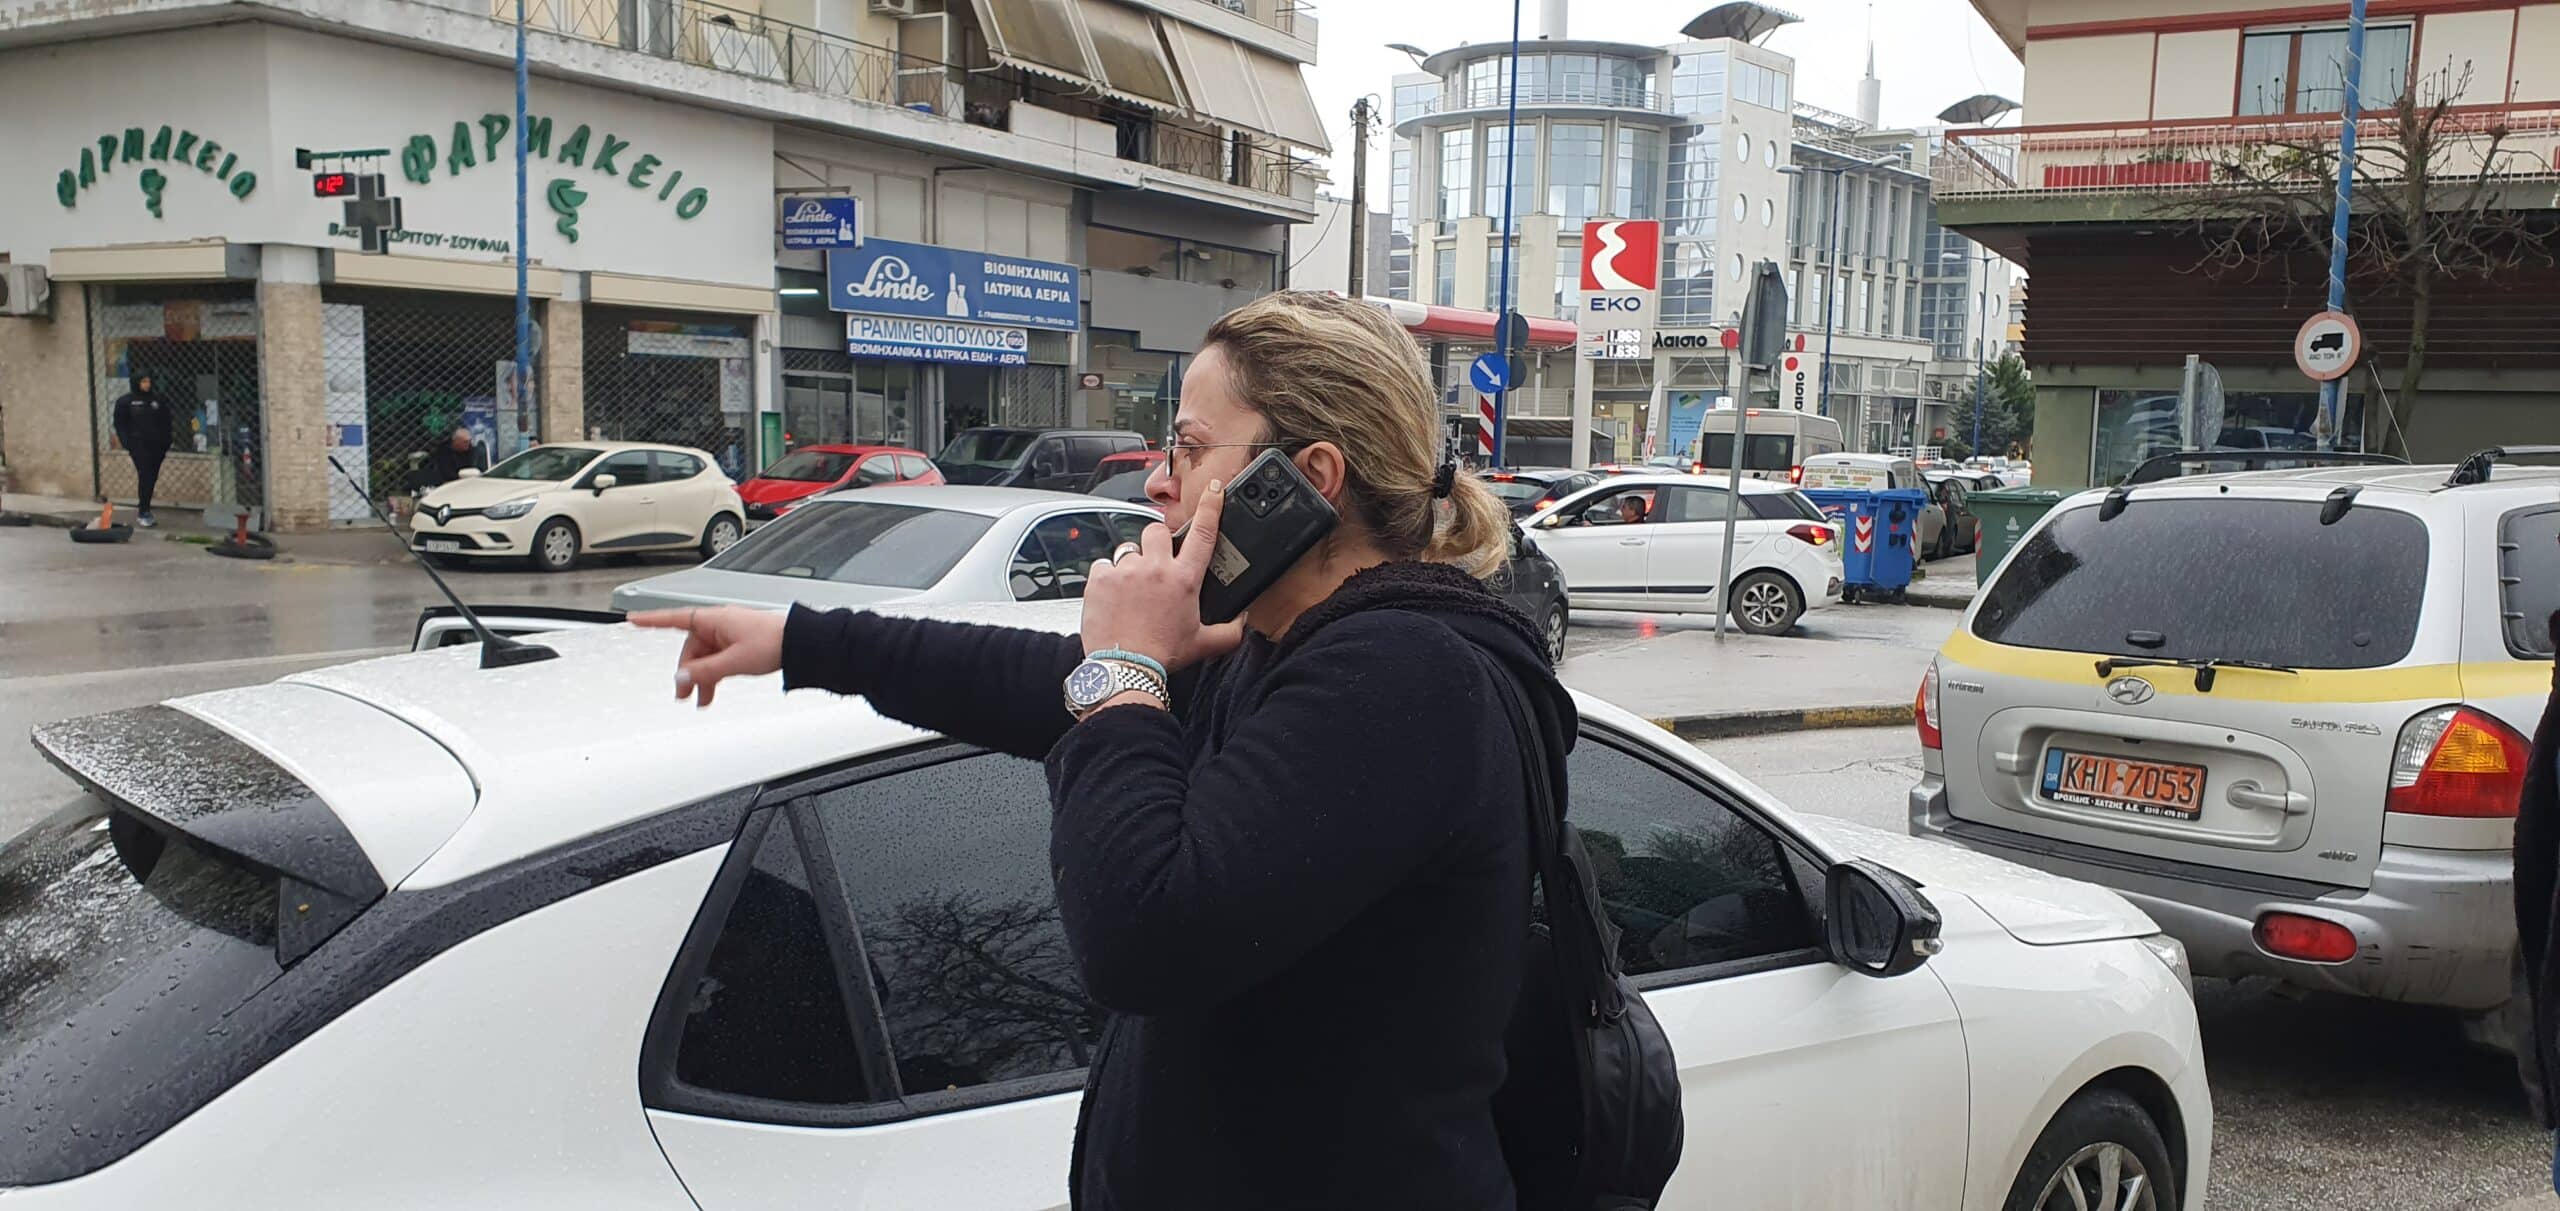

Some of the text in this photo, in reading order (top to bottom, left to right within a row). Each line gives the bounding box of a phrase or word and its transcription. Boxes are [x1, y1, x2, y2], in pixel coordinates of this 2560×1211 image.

[57, 125, 257, 208] ΦΑΡΜΑΚΕΙΟ
[402, 113, 708, 219] ΦΑΡΜΑΚΕΙΟ
[785, 201, 836, 223] Linde
[847, 255, 935, 302] Linde
[984, 261, 1070, 284] ΒΙΟΜΗΧΑΝΙΚΑ
[984, 281, 1071, 303] ΙΑΤΡΙΚΑ ΑΕΡΙΑ
[1591, 297, 1641, 312] EKO
[850, 318, 1005, 347] ΓΡΑΜΜΕΝΟΠΟΥΛΟΣ
[1653, 331, 1708, 348] λαισιο
[850, 343, 923, 358] ΒΙΟΜΗΧΑΝΙΚΑ
[933, 350, 969, 361] ΙΑΤΡΙΚΑ
[971, 353, 993, 362] ΕΙΔΗ
[1000, 354, 1025, 365] ΑΕΡΙΑ
[2046, 773, 2058, 782] GR
